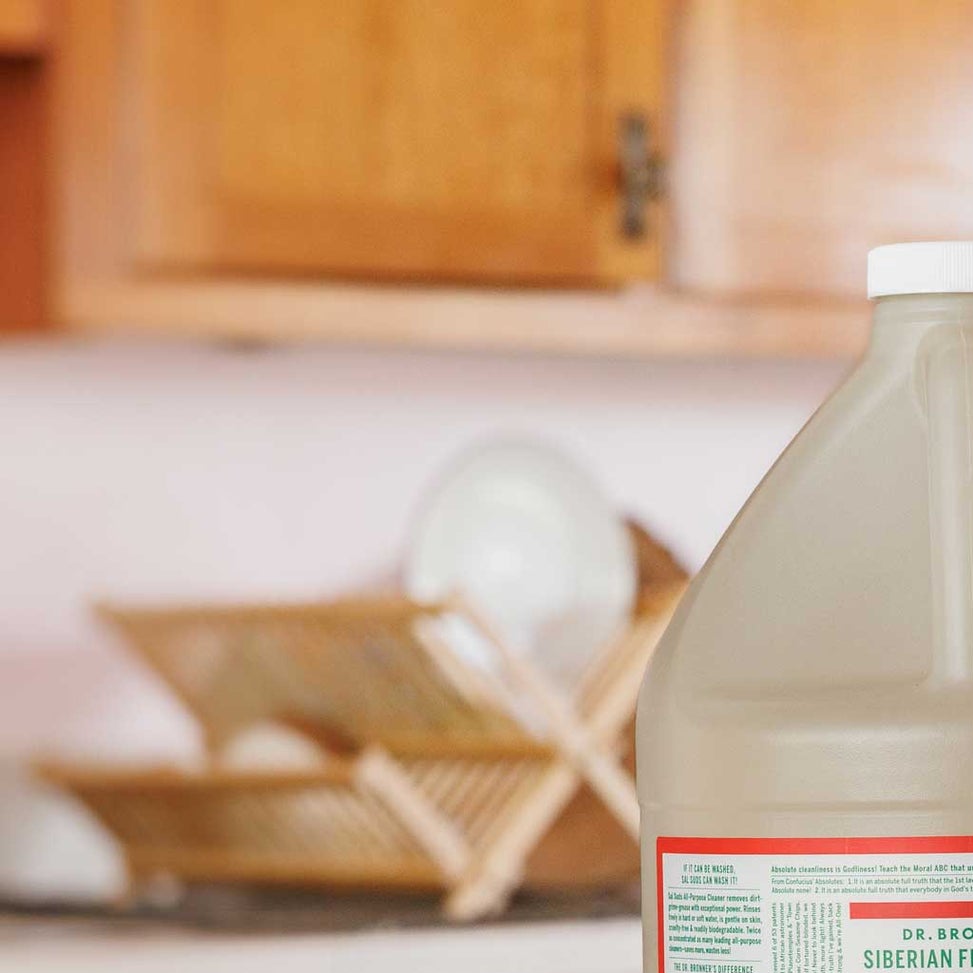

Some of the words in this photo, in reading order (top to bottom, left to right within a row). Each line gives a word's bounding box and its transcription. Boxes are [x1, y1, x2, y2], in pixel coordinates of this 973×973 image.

[798, 865, 834, 873] cleanliness
[842, 865, 877, 873] Godliness!
[879, 865, 898, 873] Teach
[913, 864, 933, 872] Moral
[934, 864, 948, 872] ABC
[950, 864, 965, 872] that
[903, 928, 932, 940] DR.
[864, 949, 952, 969] SIBERIAN
